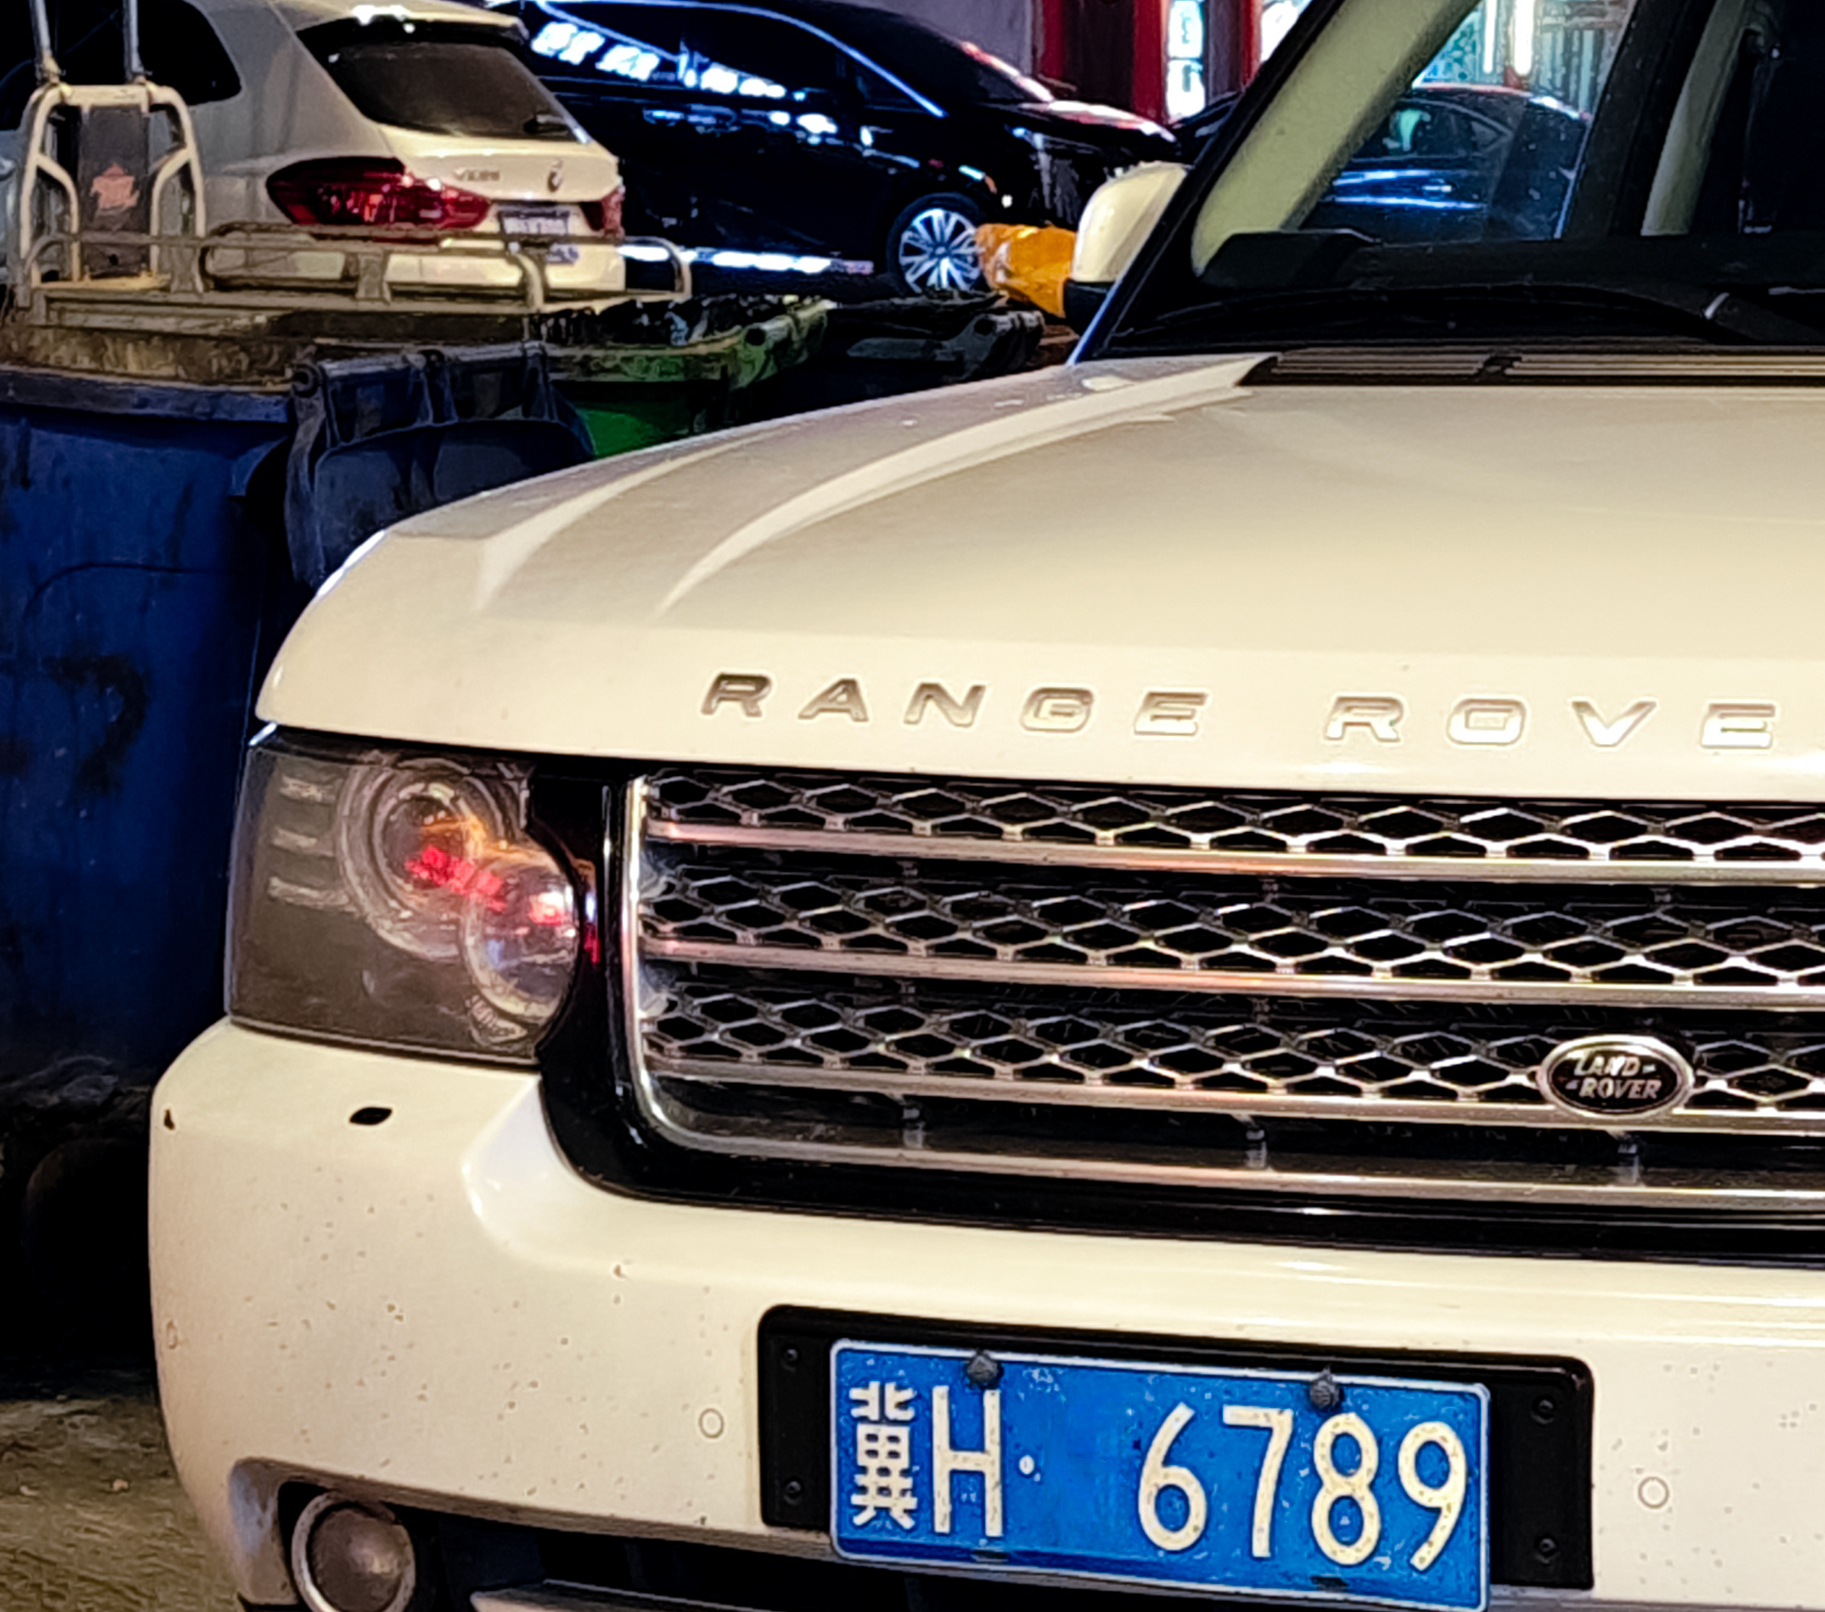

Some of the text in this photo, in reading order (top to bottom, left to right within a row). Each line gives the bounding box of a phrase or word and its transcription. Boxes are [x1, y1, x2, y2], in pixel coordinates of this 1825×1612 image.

[700, 672, 1209, 737] RANGE
[1574, 1055, 1641, 1077] LAND
[1579, 1077, 1662, 1100] ROVER
[1136, 1401, 1468, 1572] 6789
